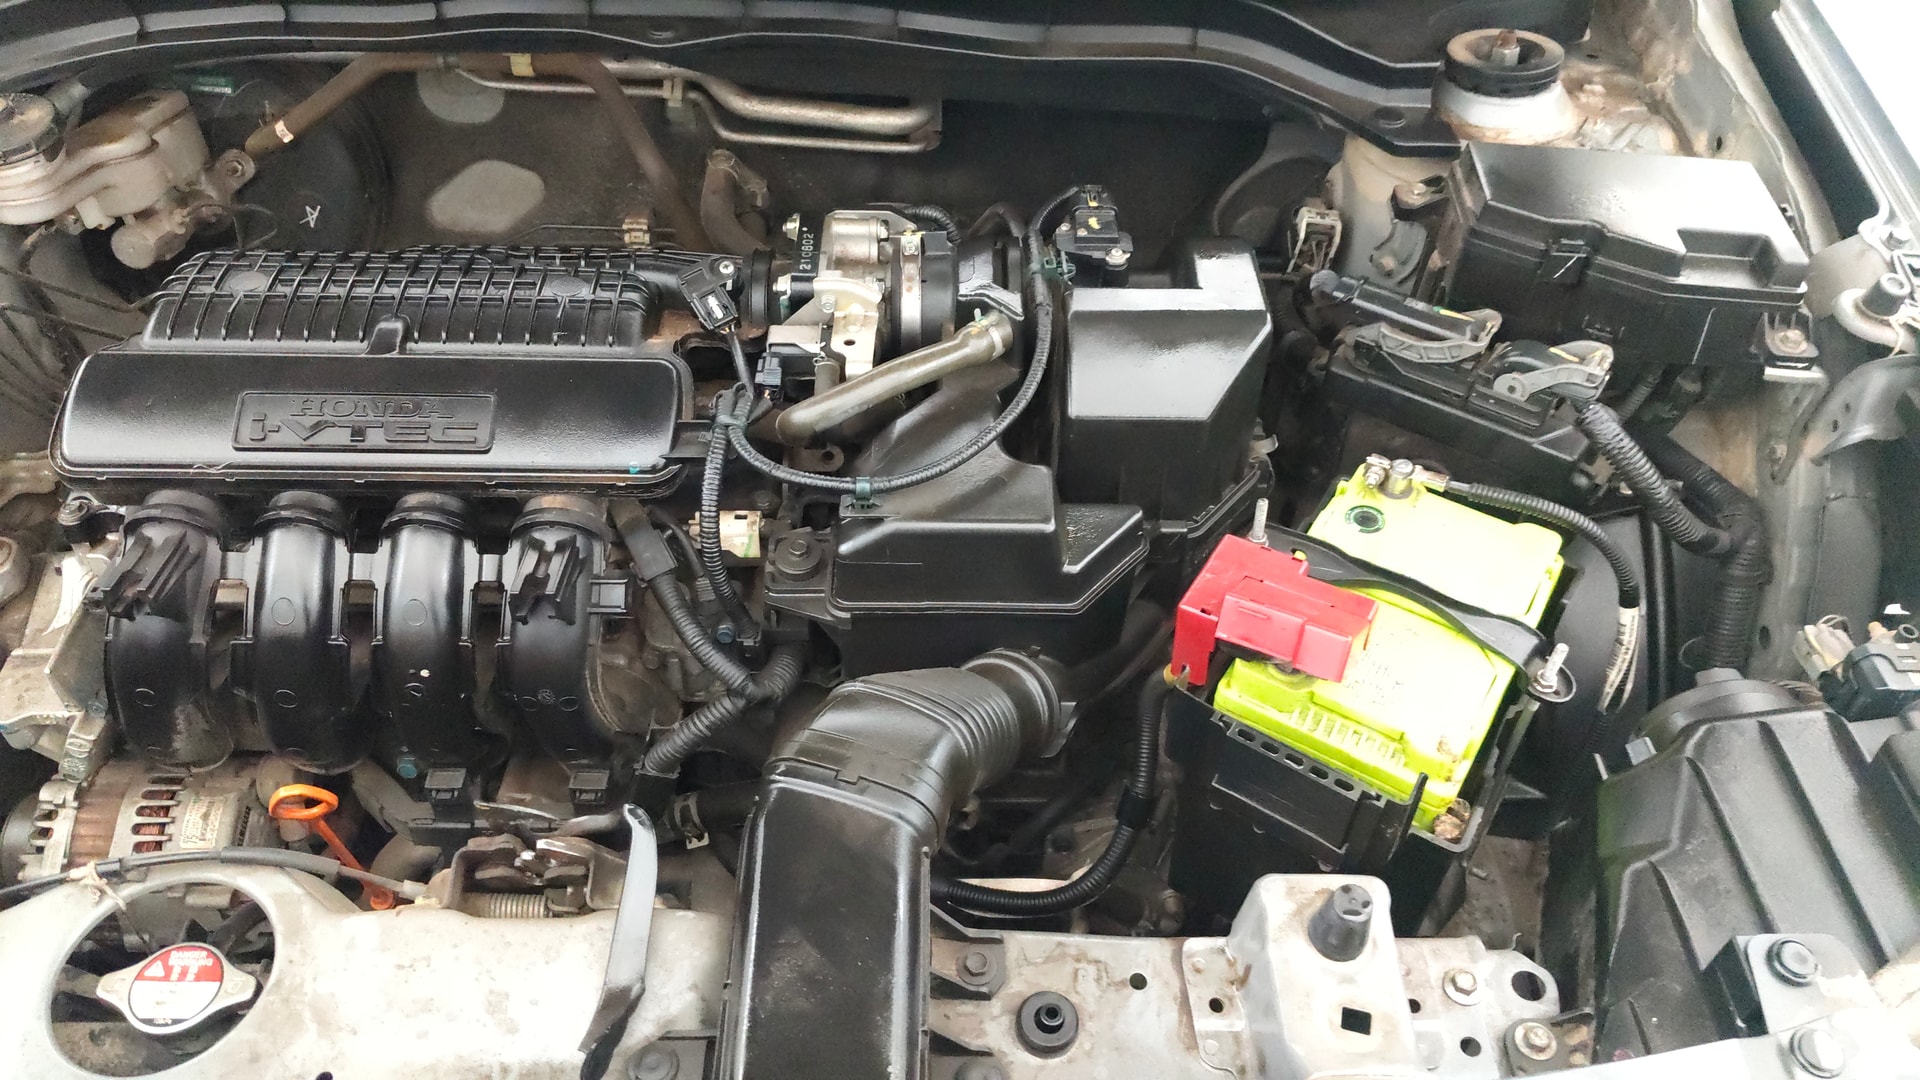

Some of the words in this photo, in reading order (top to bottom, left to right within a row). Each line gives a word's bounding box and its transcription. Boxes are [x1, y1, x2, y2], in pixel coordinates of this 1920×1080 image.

[799, 232, 815, 271] 210802
[290, 398, 454, 419] HONDA
[250, 412, 478, 443] i-VTEC
